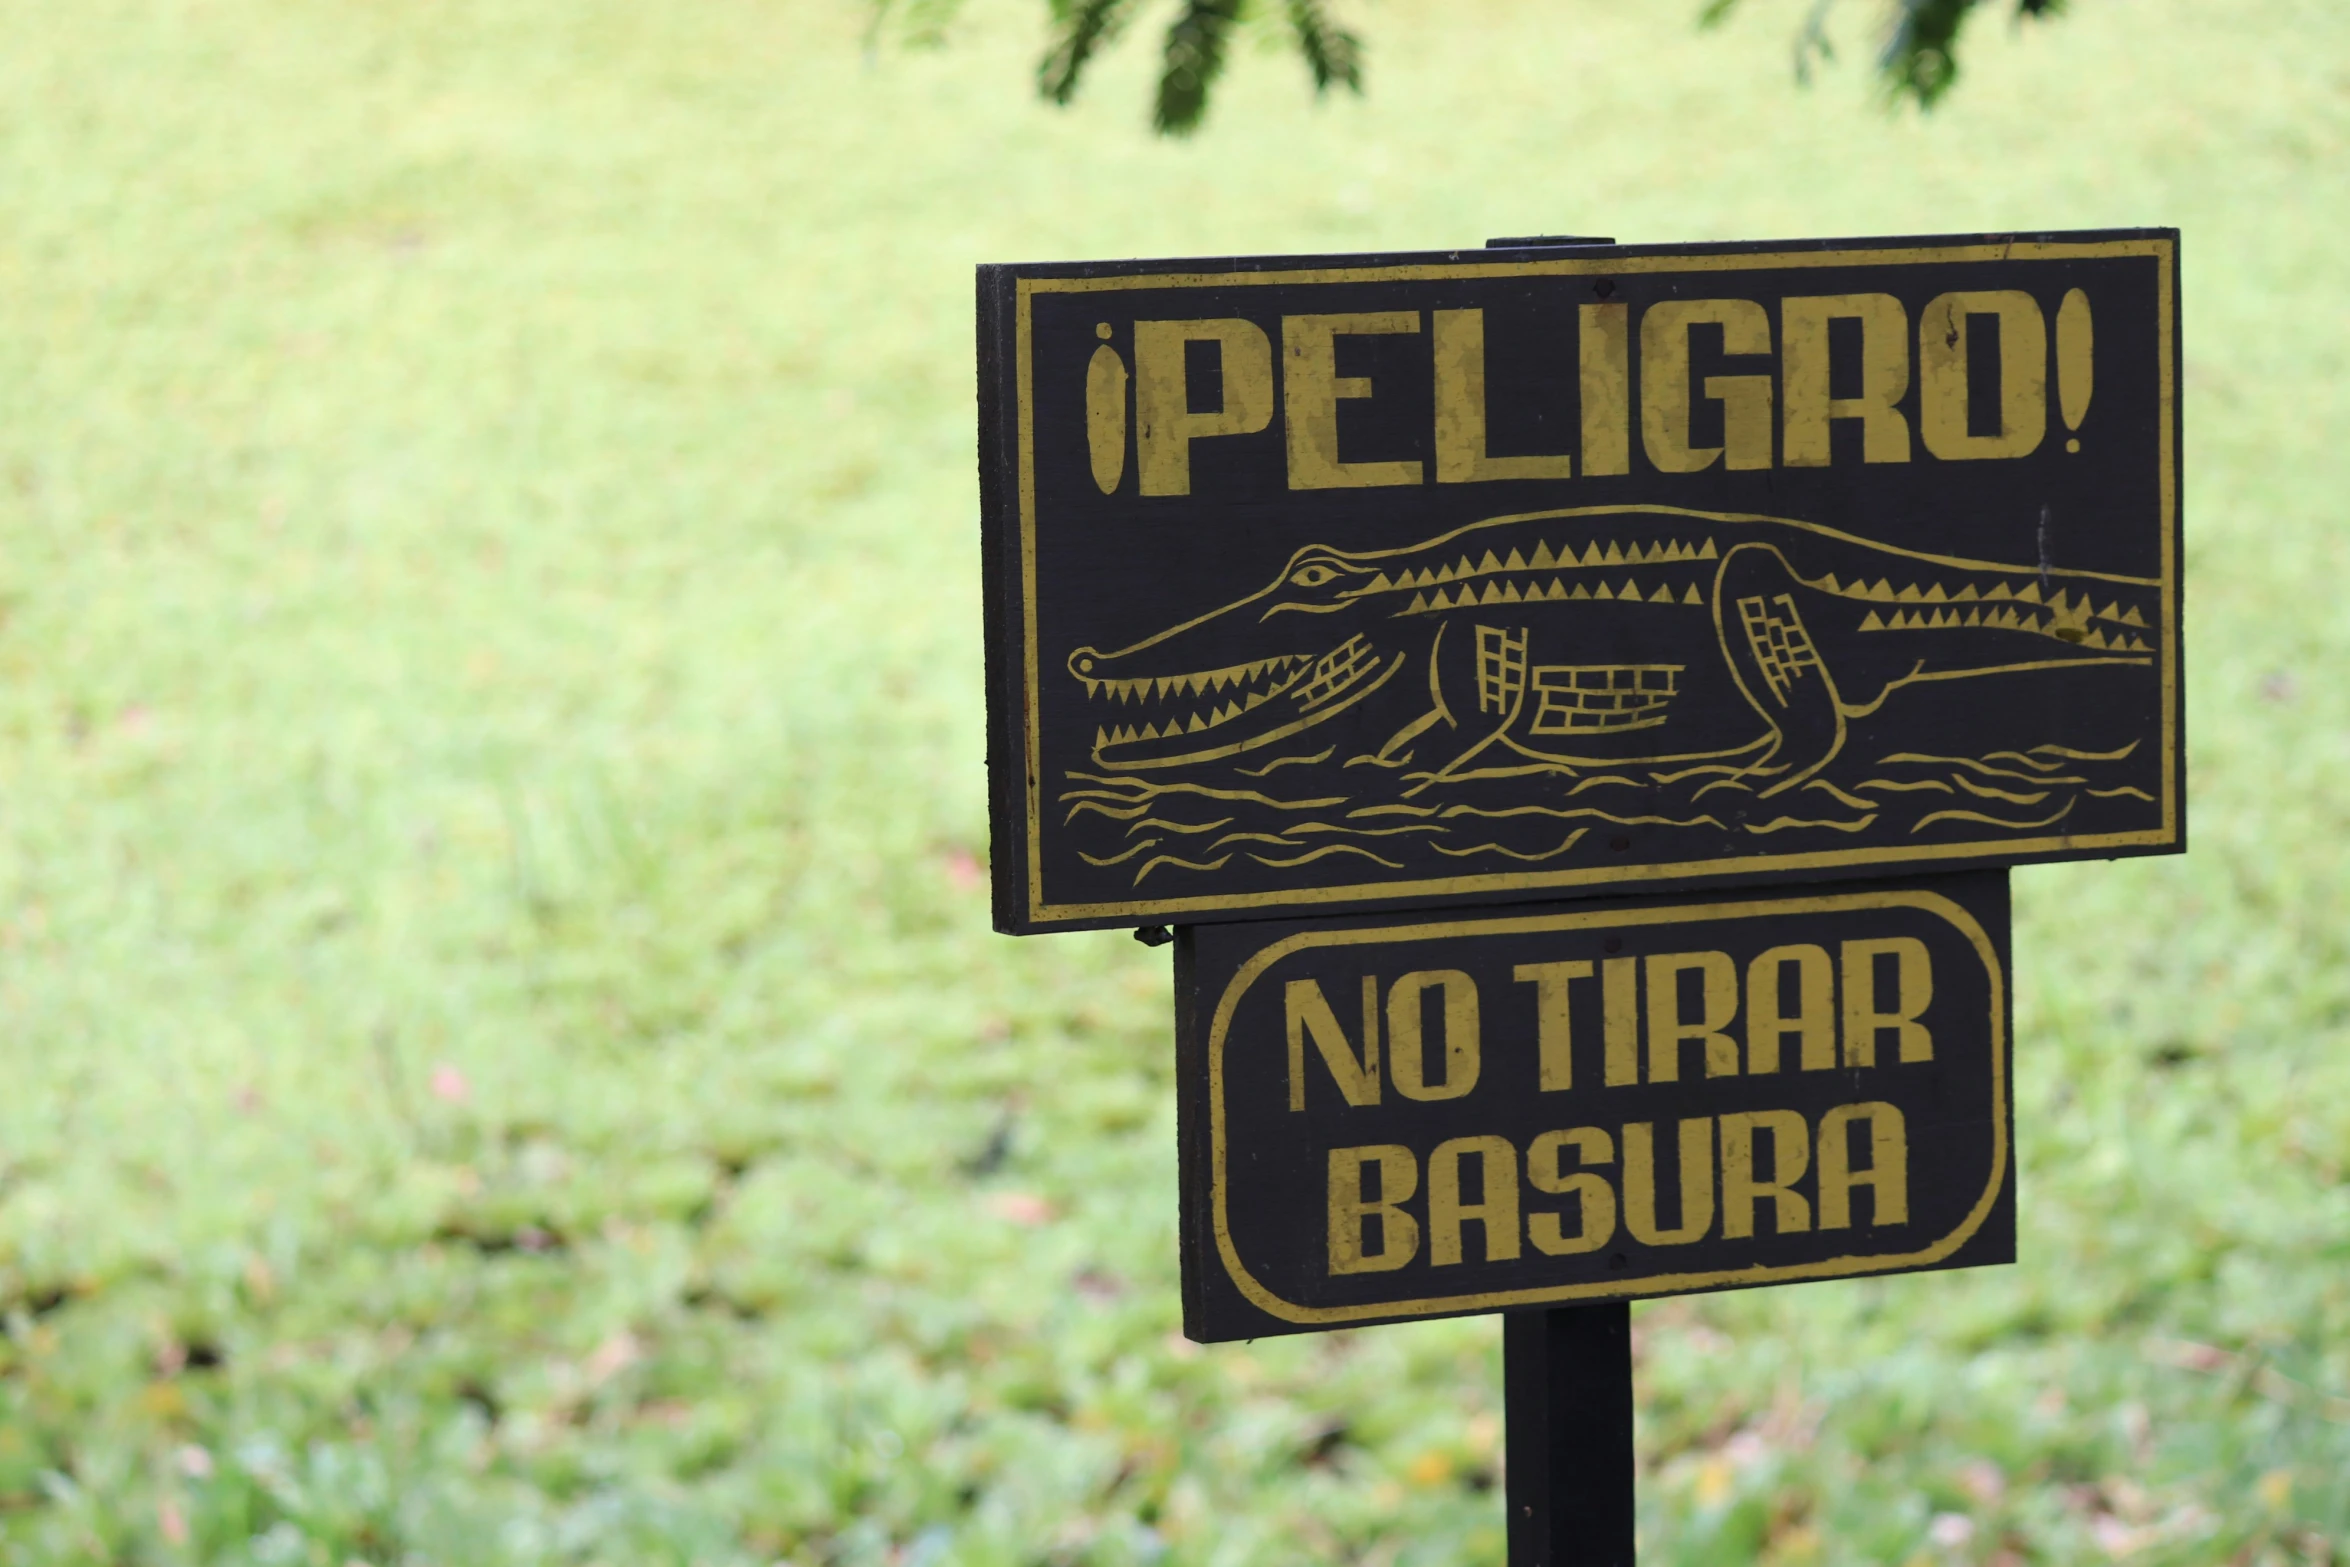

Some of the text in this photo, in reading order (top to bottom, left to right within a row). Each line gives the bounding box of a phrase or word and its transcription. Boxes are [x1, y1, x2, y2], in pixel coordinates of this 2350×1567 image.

[1085, 287, 2094, 497] ¡PELIGRO!
[1285, 936, 1934, 1112] NO TIRAR
[1327, 1101, 1908, 1276] BASURA
